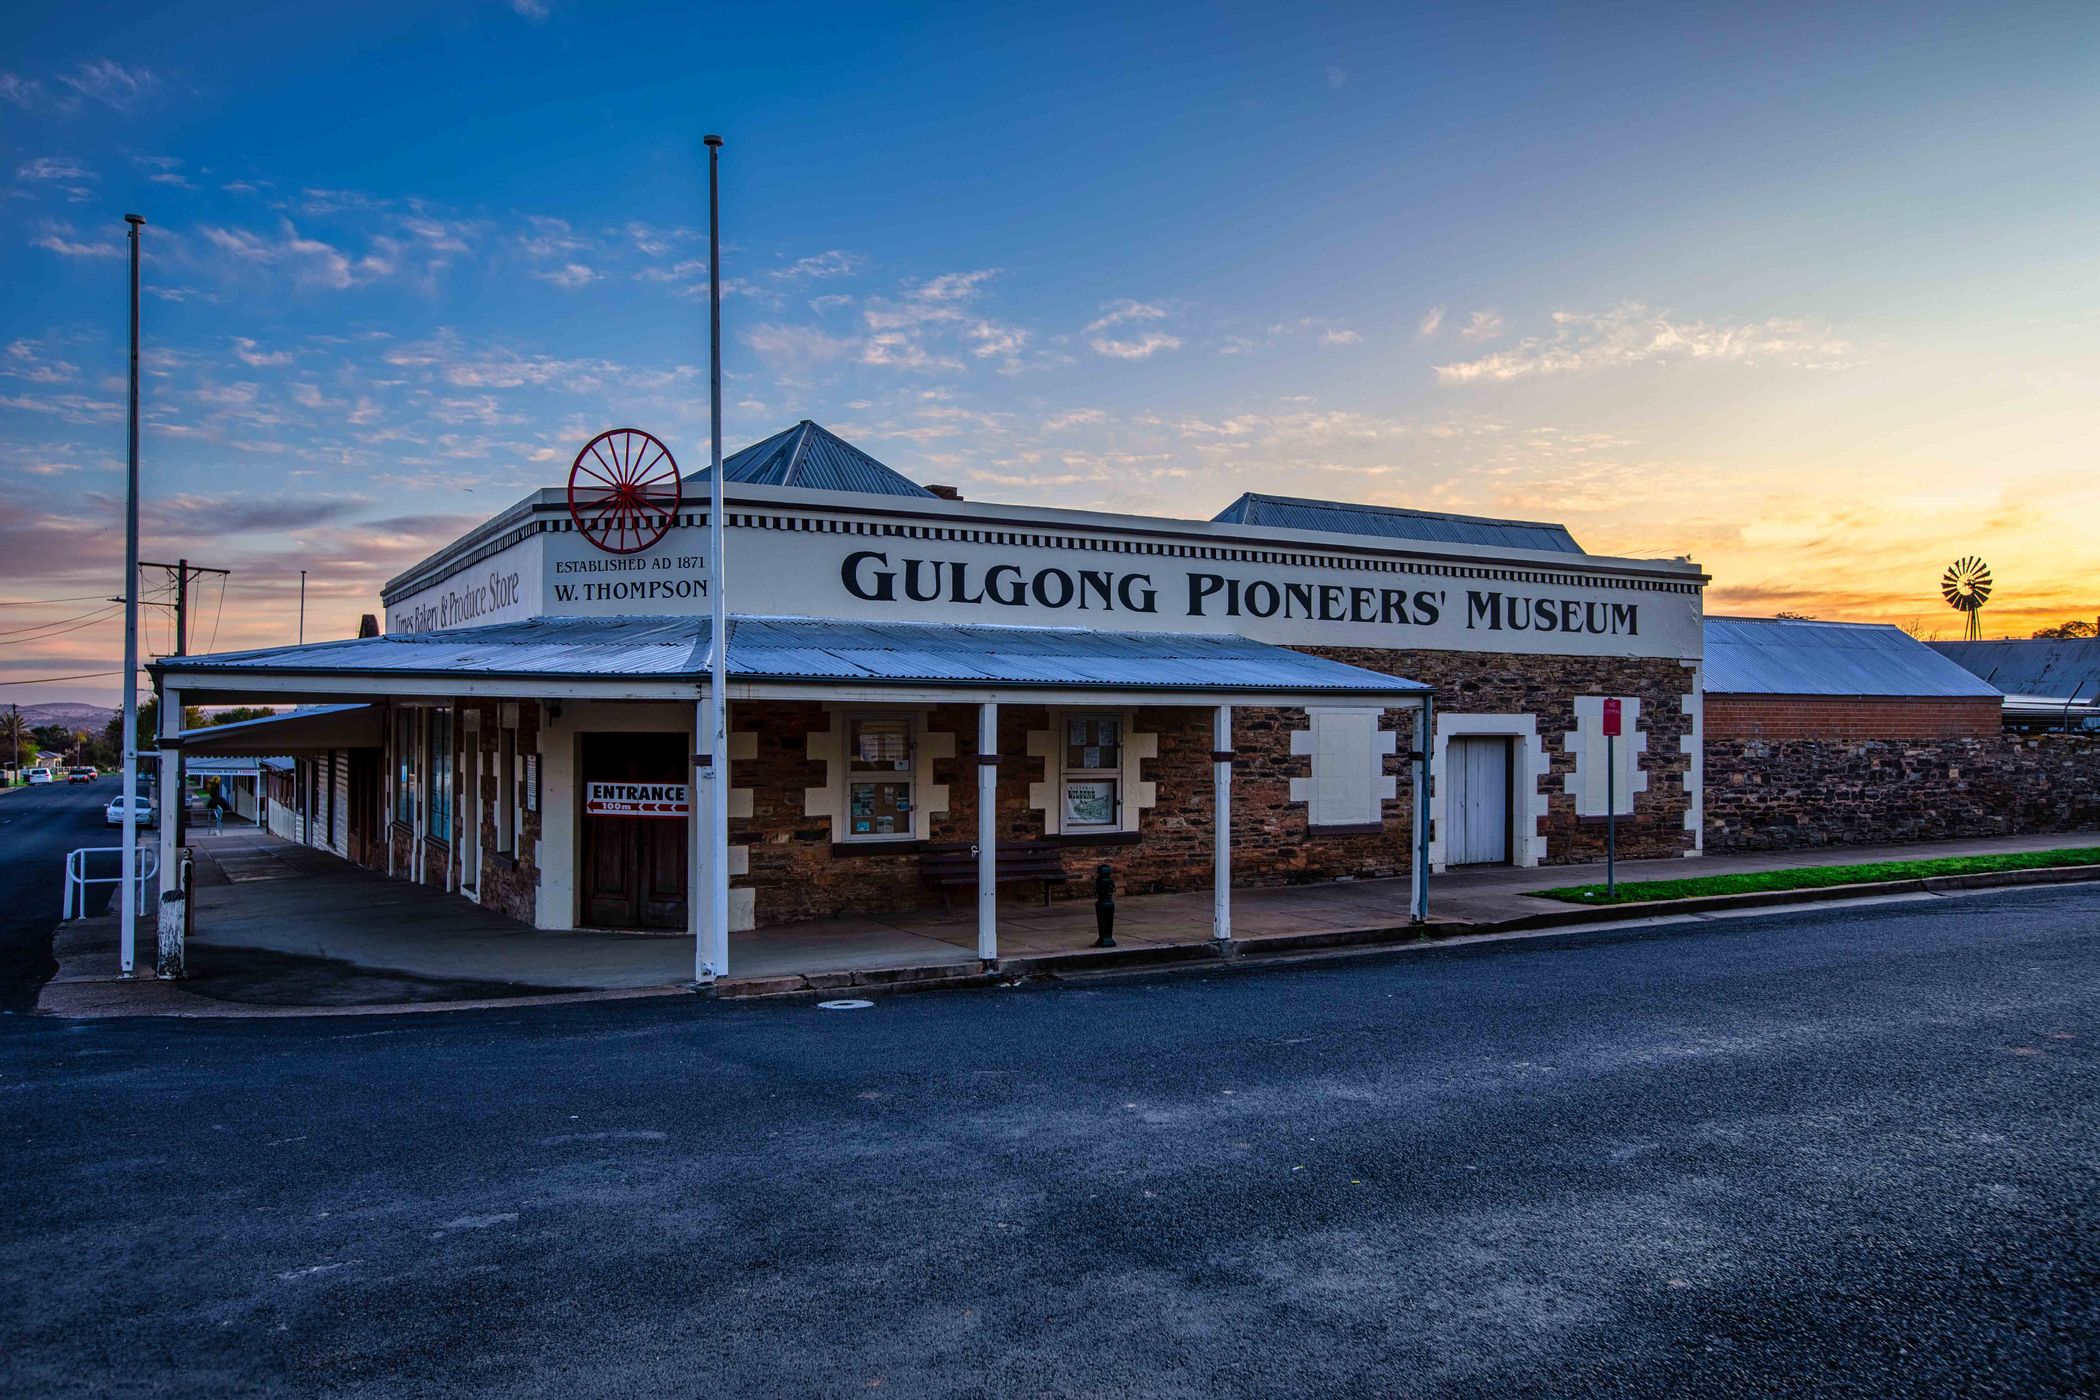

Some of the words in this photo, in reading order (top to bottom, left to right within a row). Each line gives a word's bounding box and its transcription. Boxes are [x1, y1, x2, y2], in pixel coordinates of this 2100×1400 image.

[556, 558, 646, 574] ESTABLISHED
[652, 557, 672, 570] AD
[677, 556, 705, 569] 1871
[554, 584, 579, 602] W.
[583, 579, 708, 601] THOMPSON
[840, 550, 1158, 614] GULGONG
[1185, 572, 1446, 627] PIONEERS'
[1465, 589, 1640, 637] MUSEUM
[415, 603, 440, 633] Bakery
[440, 595, 448, 628] &
[449, 584, 486, 625] Produce
[488, 571, 520, 613] Store
[593, 784, 685, 801] ENTRANCE
[602, 802, 632, 811] 100m
